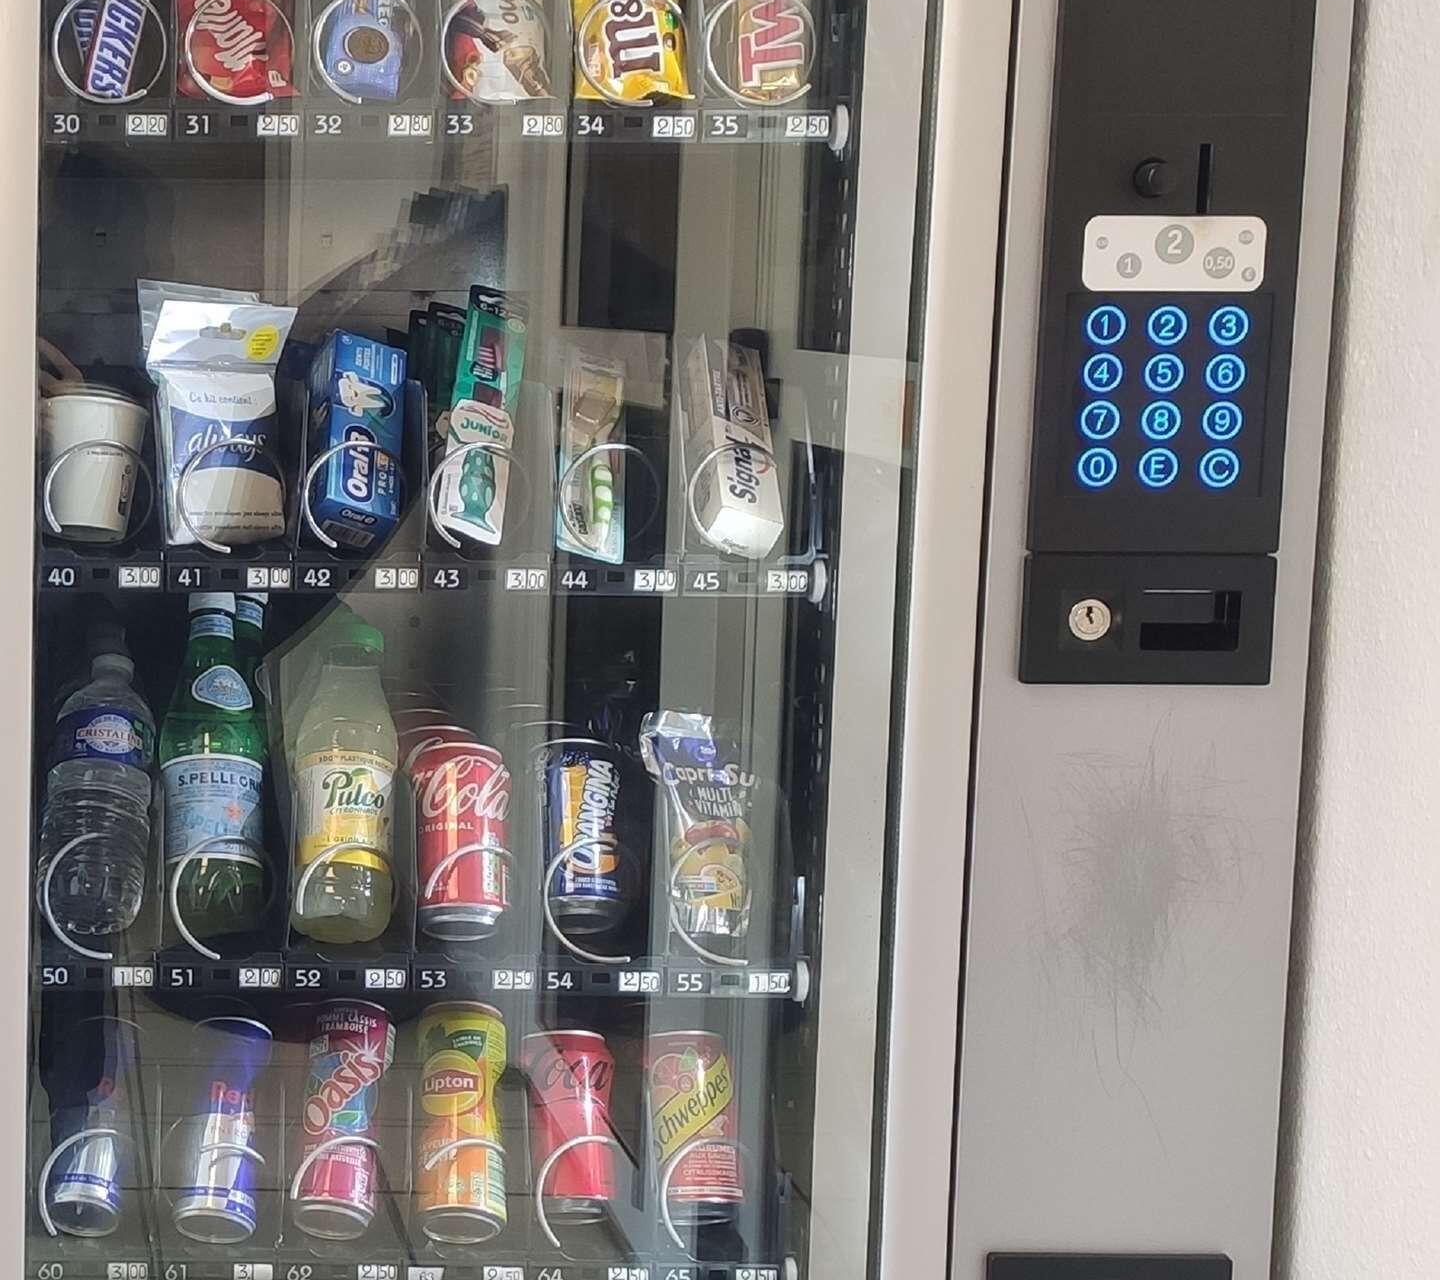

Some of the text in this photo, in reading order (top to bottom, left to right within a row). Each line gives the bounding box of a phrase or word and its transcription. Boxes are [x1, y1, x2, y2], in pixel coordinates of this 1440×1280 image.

[53, 115, 80, 134] 30
[186, 115, 209, 134] 31
[315, 115, 342, 134] 32
[447, 115, 473, 134] 33
[577, 115, 604, 134] 34
[712, 115, 738, 134] 35
[1166, 229, 1183, 254] 2
[1123, 257, 1134, 272] 1
[1206, 255, 1233, 272] 0,50
[1101, 315, 1109, 336] 1
[1160, 315, 1175, 337] 2
[1221, 315, 1237, 337] 3
[1093, 361, 1110, 384] 4
[1157, 362, 1172, 384] 5
[1217, 362, 1233, 384] 6
[1092, 409, 1108, 431] 7
[1153, 409, 1169, 432] 8
[1214, 409, 1230, 432] 9
[1089, 456, 1105, 479] 0
[1150, 456, 1165, 479] E
[1212, 456, 1229, 479] C
[48, 568, 75, 587] 40
[178, 568, 201, 587] 41
[304, 568, 331, 587] 42
[433, 569, 460, 589] 43
[562, 569, 589, 588] 44
[693, 571, 720, 590] 45
[322, 771, 385, 809] Pulco
[42, 967, 68, 985] 50
[171, 969, 194, 986] 51
[295, 969, 321, 987] 52
[420, 970, 447, 989] 53
[547, 971, 574, 989] 54
[677, 972, 703, 990] 55
[424, 1076, 474, 1093] Lipton
[38, 1264, 63, 1280] 60
[164, 1264, 188, 1280] 61
